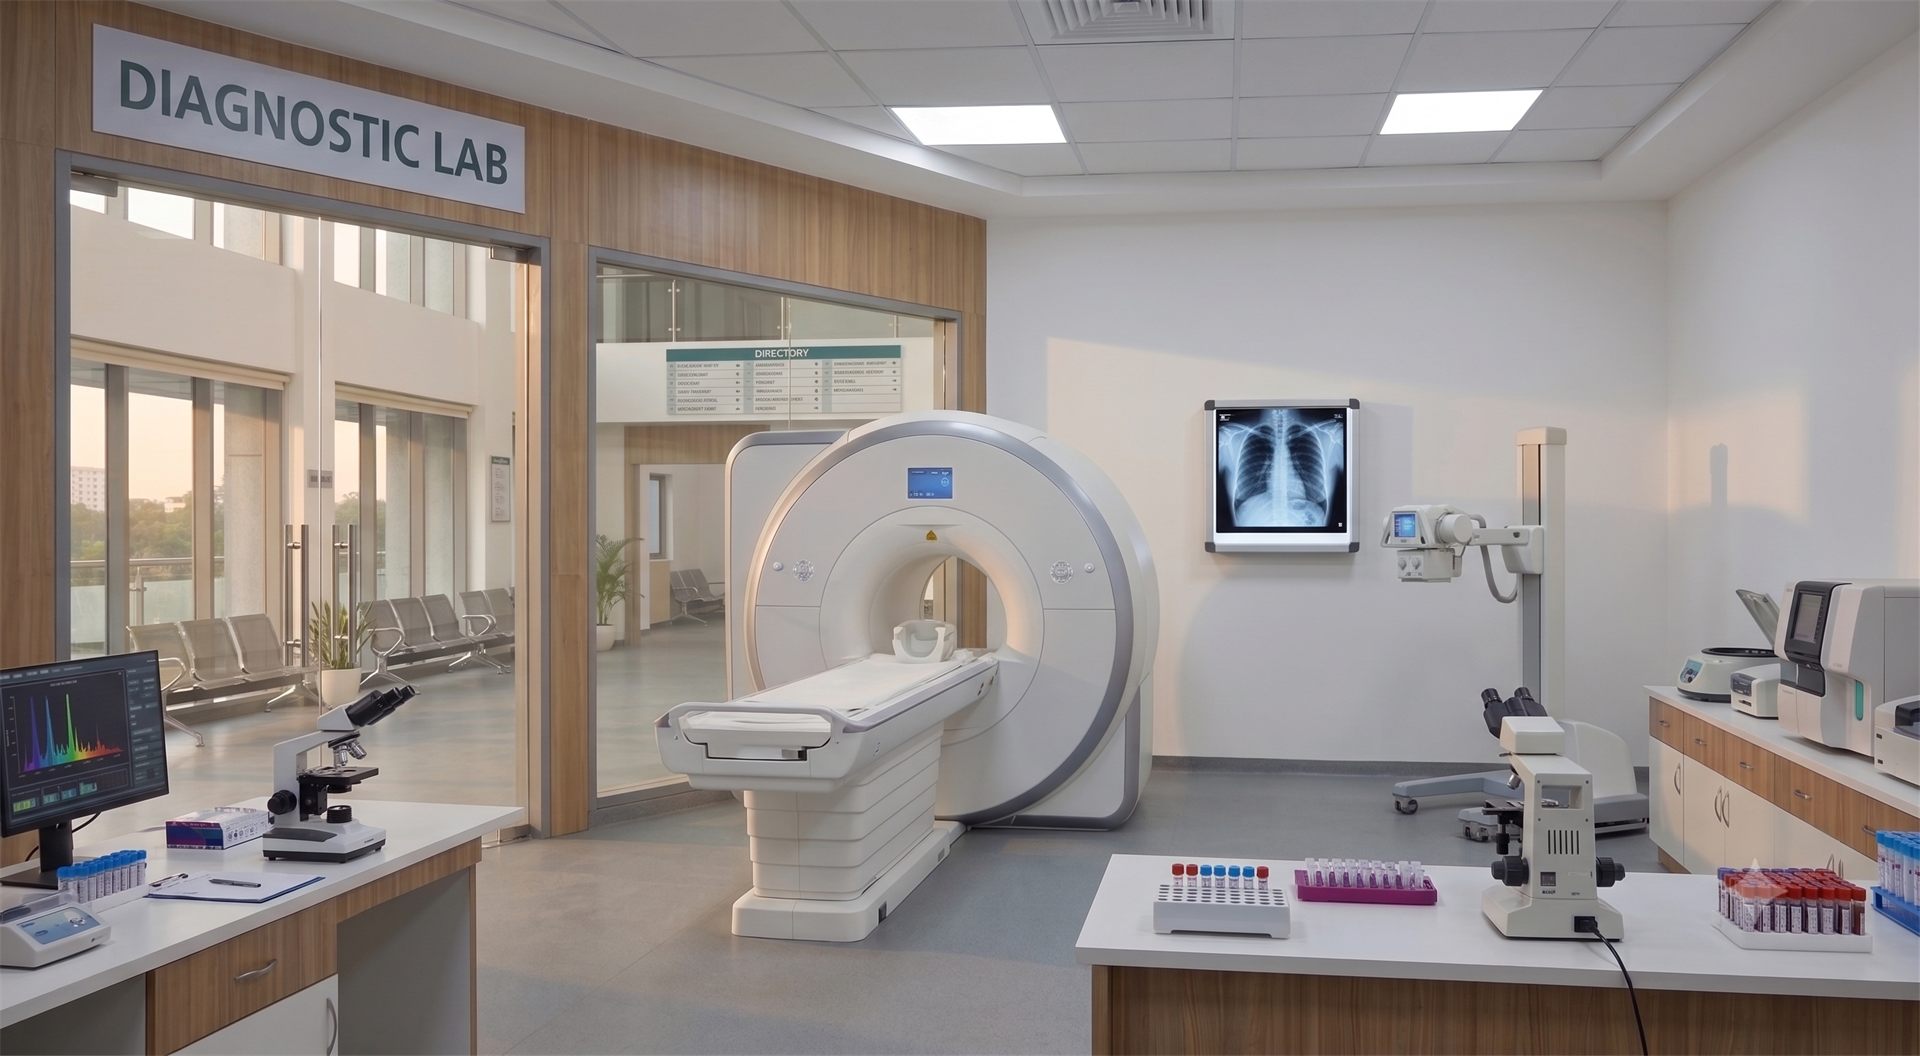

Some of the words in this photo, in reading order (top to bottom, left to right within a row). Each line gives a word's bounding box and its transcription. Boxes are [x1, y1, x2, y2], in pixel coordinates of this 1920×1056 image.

[120, 58, 420, 169] DIAGNOSTIC
[434, 131, 509, 186] LAB
[754, 348, 809, 359] DIRECTORY
